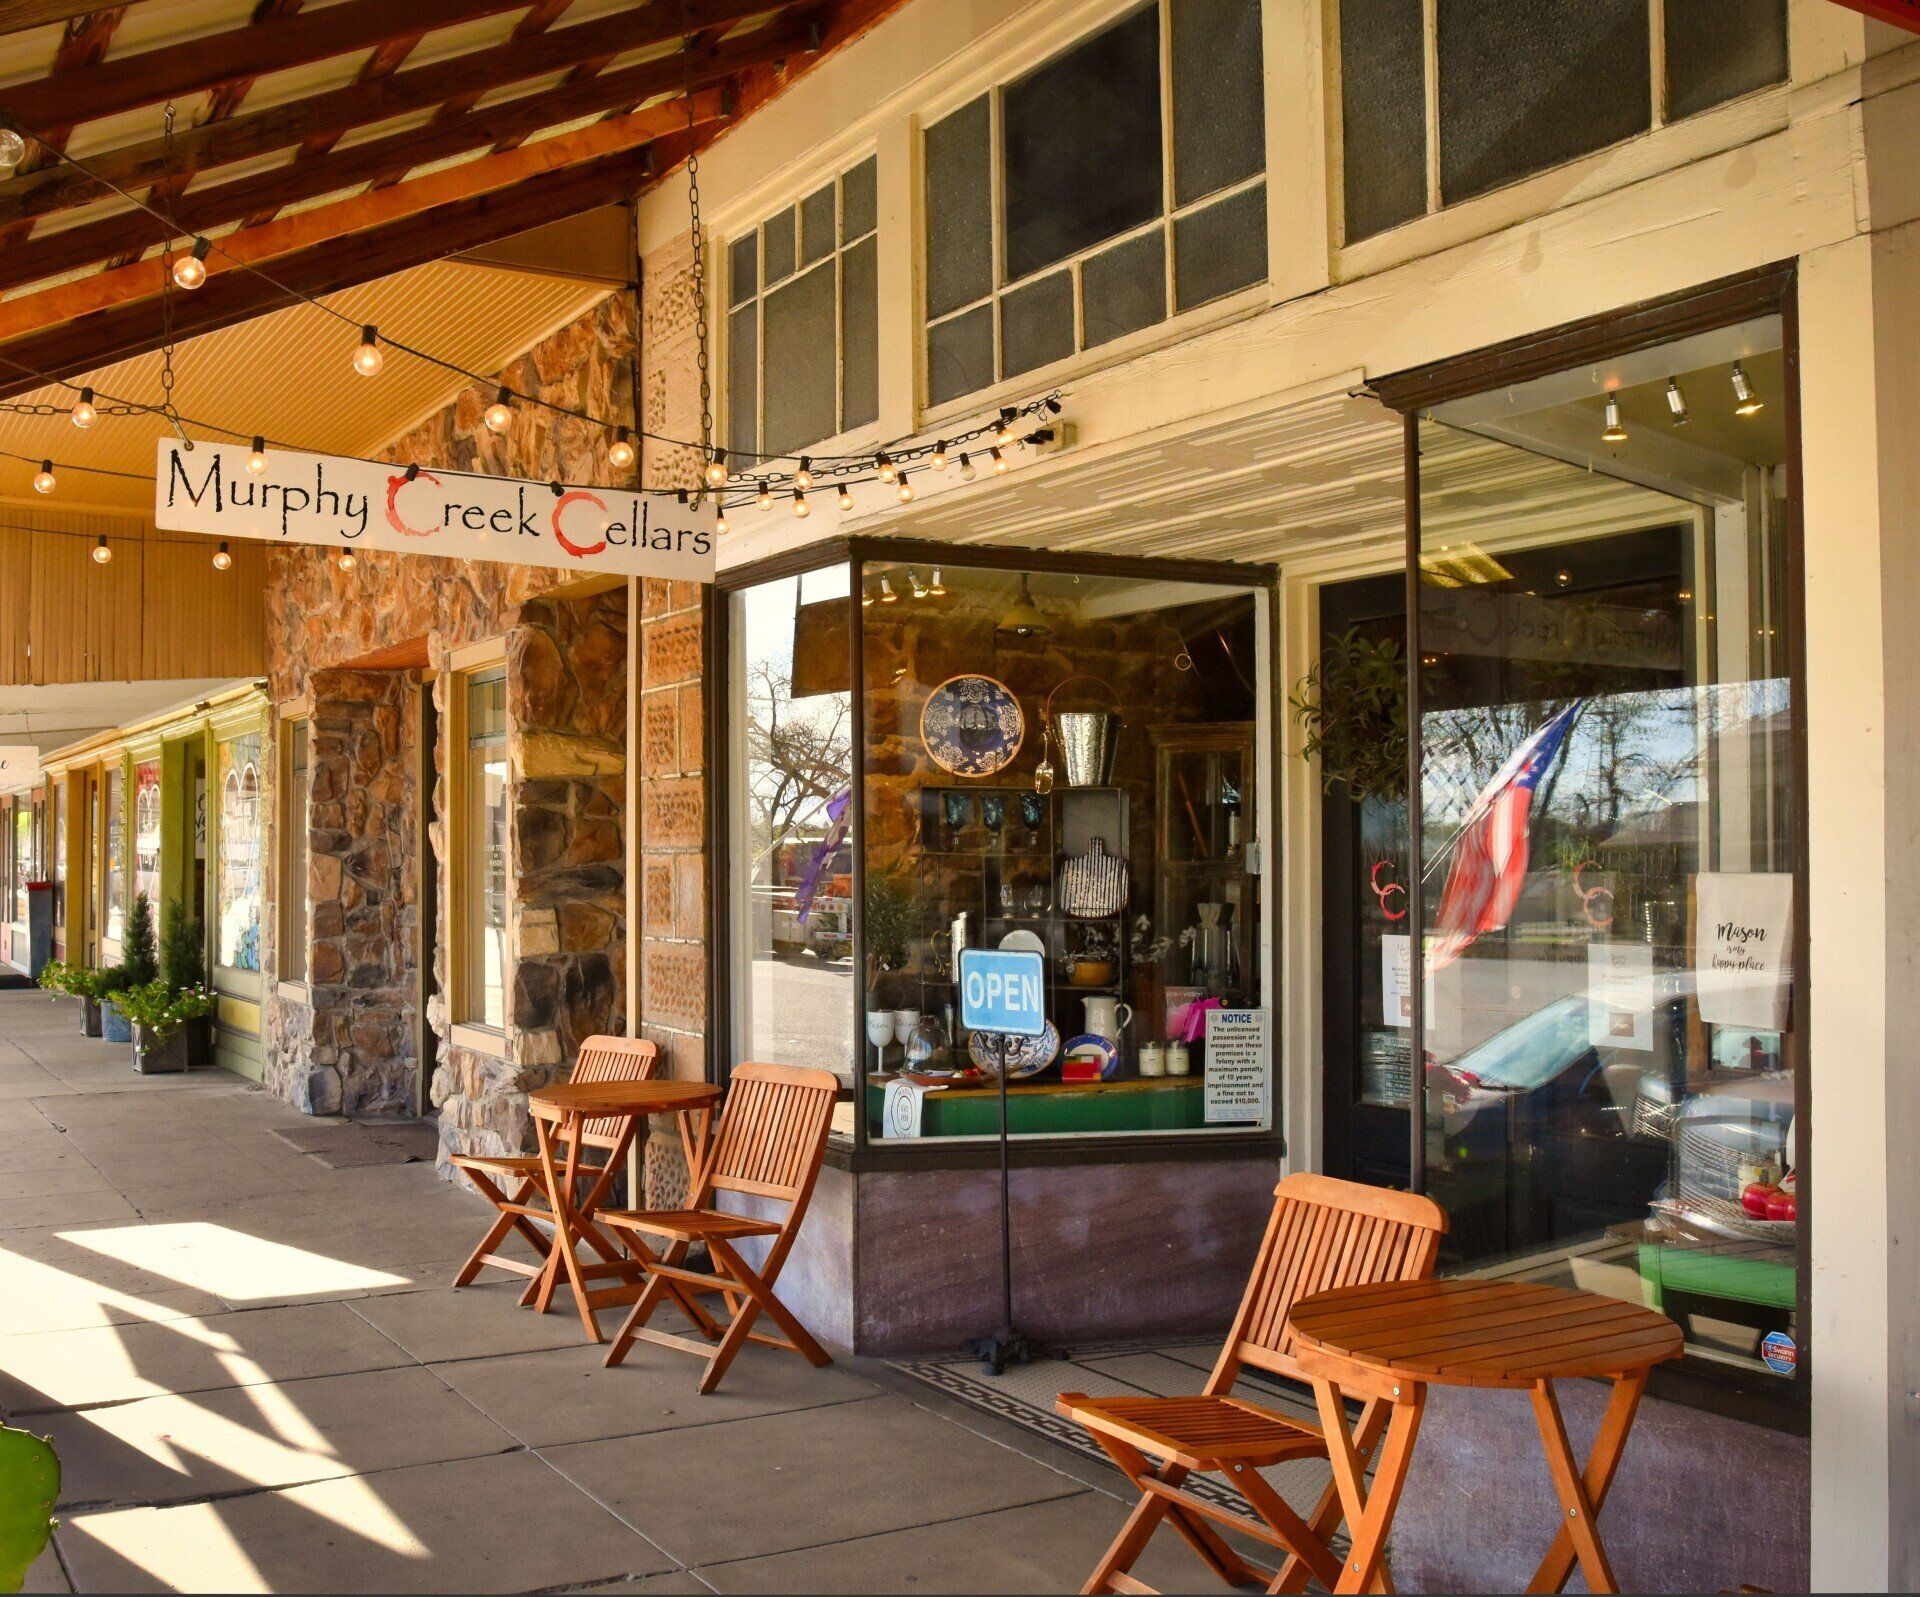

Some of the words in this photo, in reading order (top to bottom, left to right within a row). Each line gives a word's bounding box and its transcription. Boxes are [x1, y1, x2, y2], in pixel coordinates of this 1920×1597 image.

[167, 449, 368, 538] Murphy
[385, 471, 540, 537] Creek
[552, 491, 711, 558] Cellars
[1715, 922, 1767, 943] Mason
[1726, 945, 1732, 954] is
[1732, 946, 1747, 956] my
[1712, 953, 1738, 974] happy
[1738, 956, 1766, 974] place
[966, 971, 1039, 1012] OPEN
[1221, 1013, 1252, 1024] NOTICE
[1234, 1097, 1261, 1105] $10,000.
[1767, 1352, 1792, 1362] SECURITY
[1772, 1345, 1794, 1357] Swann
